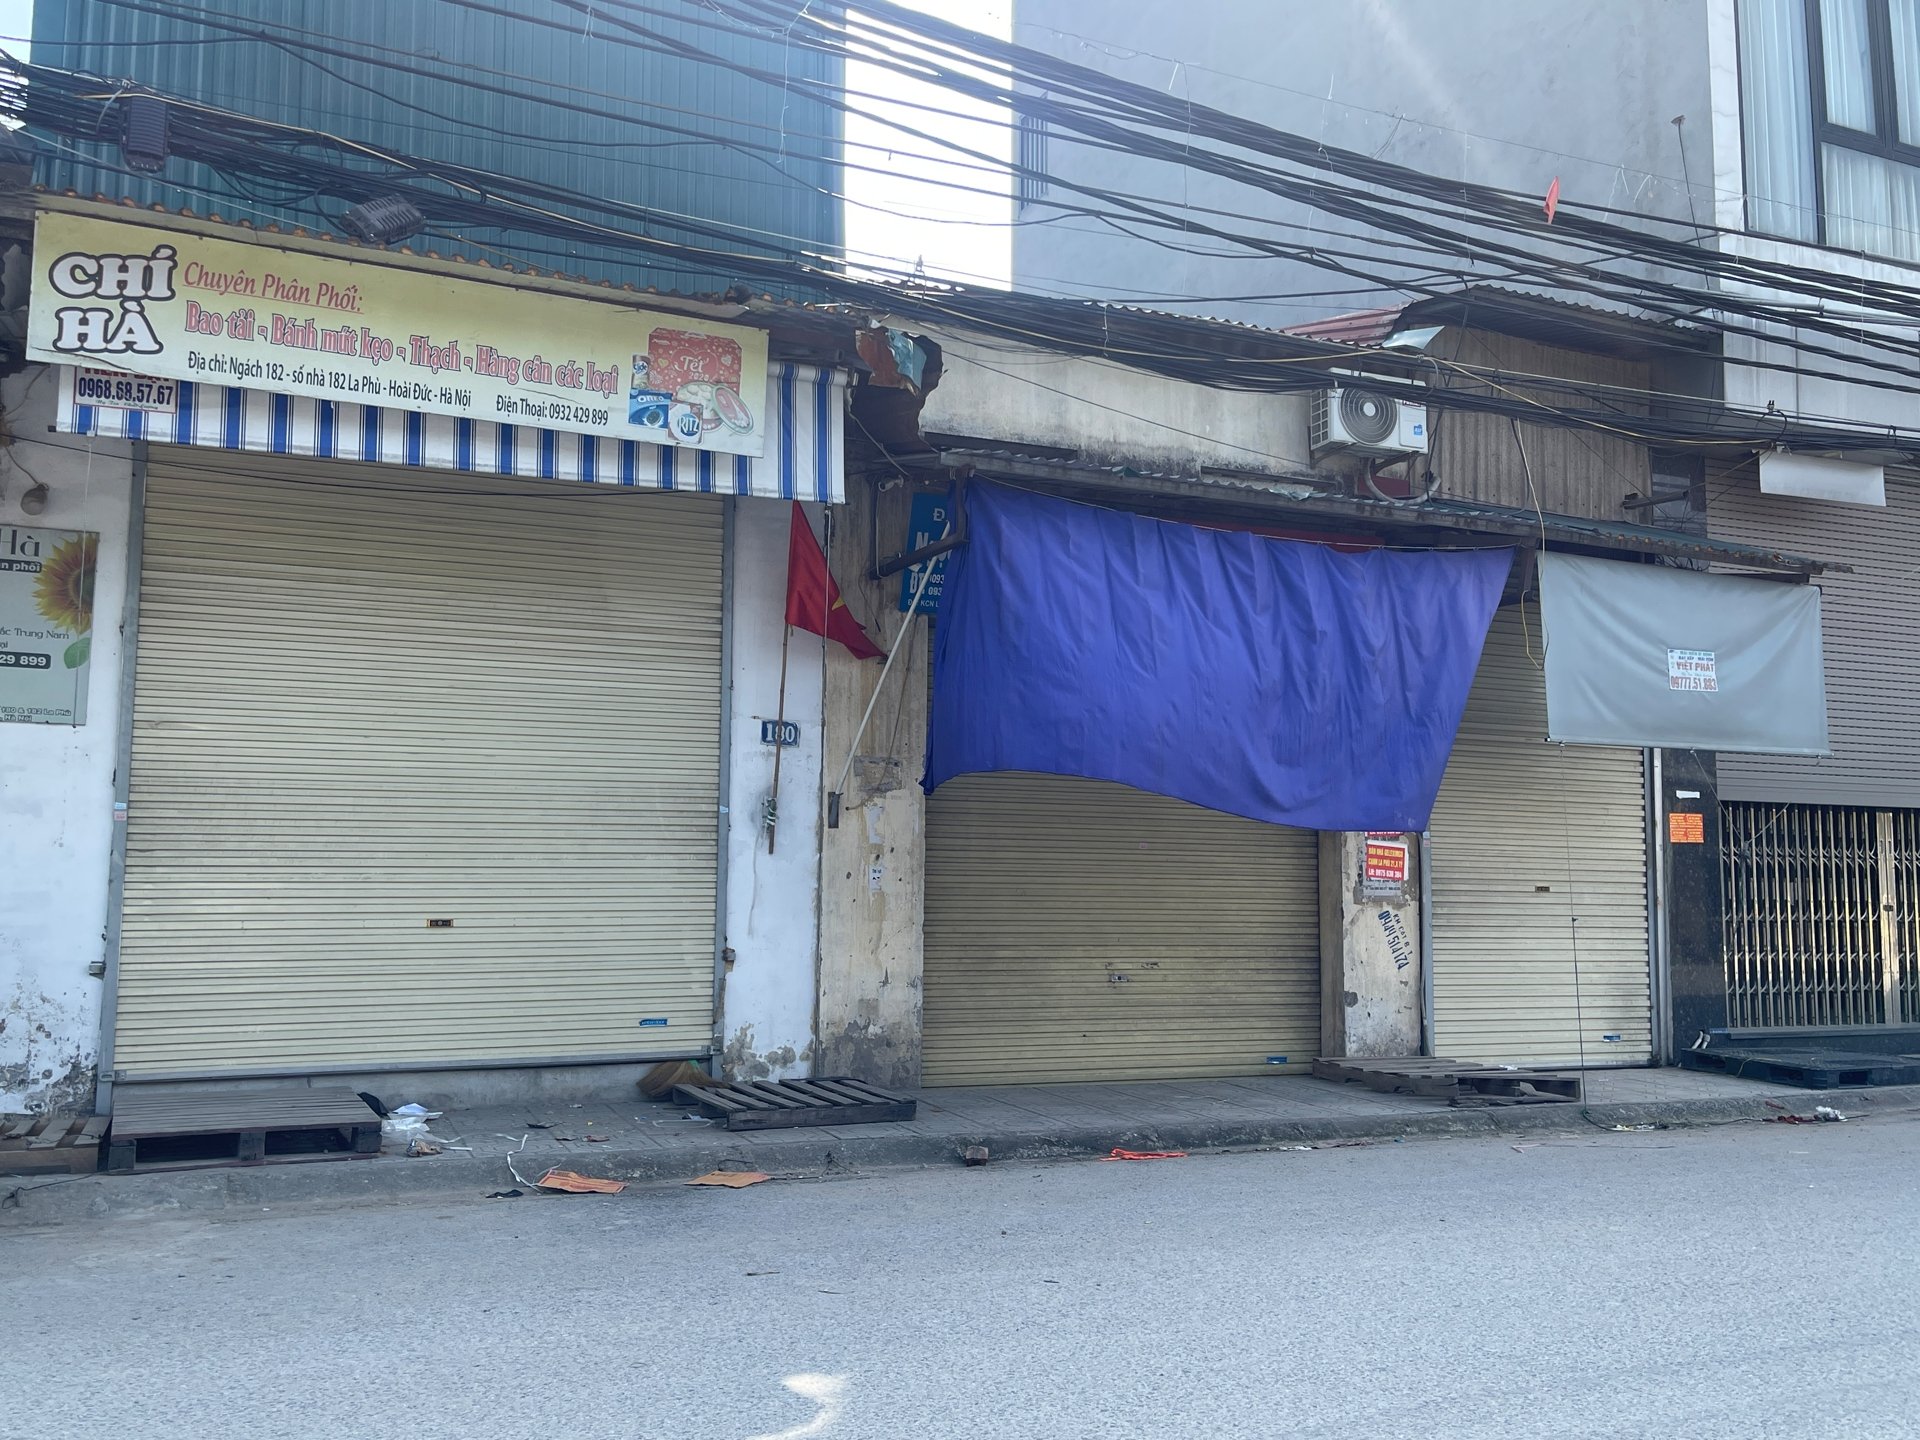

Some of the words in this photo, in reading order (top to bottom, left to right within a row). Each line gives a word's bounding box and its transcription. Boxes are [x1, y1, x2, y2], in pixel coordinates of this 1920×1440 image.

[48, 244, 178, 301] CHÍ
[184, 262, 256, 295] Chuyên
[262, 274, 310, 303] Phân
[316, 282, 362, 312] Phối:
[52, 300, 164, 354] HÀ
[185, 300, 223, 336] Bao
[225, 308, 255, 341] tải
[270, 313, 318, 350] Bánh
[320, 326, 358, 356] mứt
[359, 327, 393, 366] kẹo
[410, 334, 461, 374] Thạch
[475, 344, 520, 384] Hàng
[522, 354, 552, 384] cân
[556, 360, 584, 389] các
[586, 361, 618, 399] loại
[188, 351, 206, 374] Địa
[208, 354, 227, 373] chỉ:
[230, 356, 262, 380] Ngách
[266, 362, 284, 381] 182
[292, 364, 304, 384] số
[306, 366, 324, 387] nhà
[328, 372, 346, 390] 182
[348, 374, 358, 392] La
[362, 376, 380, 394] Phù
[389, 380, 411, 399] Hoài
[413, 382, 432, 402] Đức
[440, 386, 452, 404] Hà
[455, 388, 472, 410] Nội
[496, 394, 518, 417] Điện
[520, 398, 547, 421] Thoại:
[550, 403, 571, 421] 0932
[573, 406, 590, 424] 429
[592, 408, 608, 426] 899
[680, 356, 709, 372] Tết
[679, 417, 700, 434] RITZ
[14, 628, 43, 639] Trung
[46, 630, 70, 640] Nam
[20, 656, 46, 666] 899
